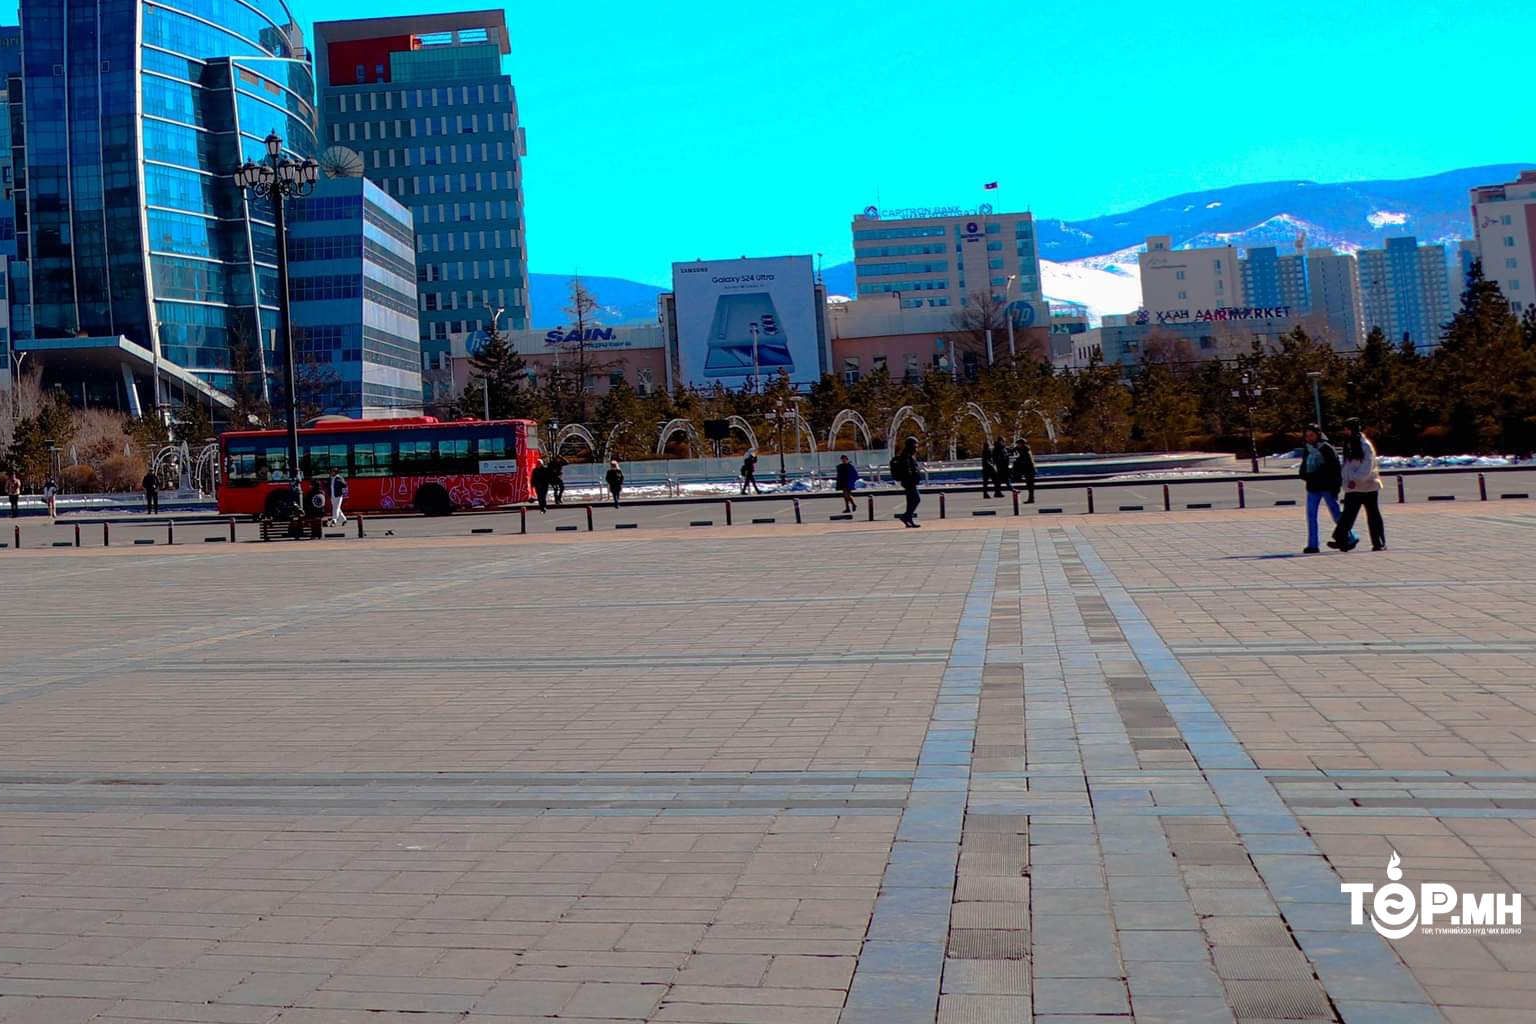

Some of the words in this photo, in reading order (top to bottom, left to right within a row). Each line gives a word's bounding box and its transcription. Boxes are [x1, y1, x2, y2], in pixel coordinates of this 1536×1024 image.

[711, 276, 740, 284] Galaxy
[741, 274, 754, 282] S24
[755, 273, 776, 281] Ultra
